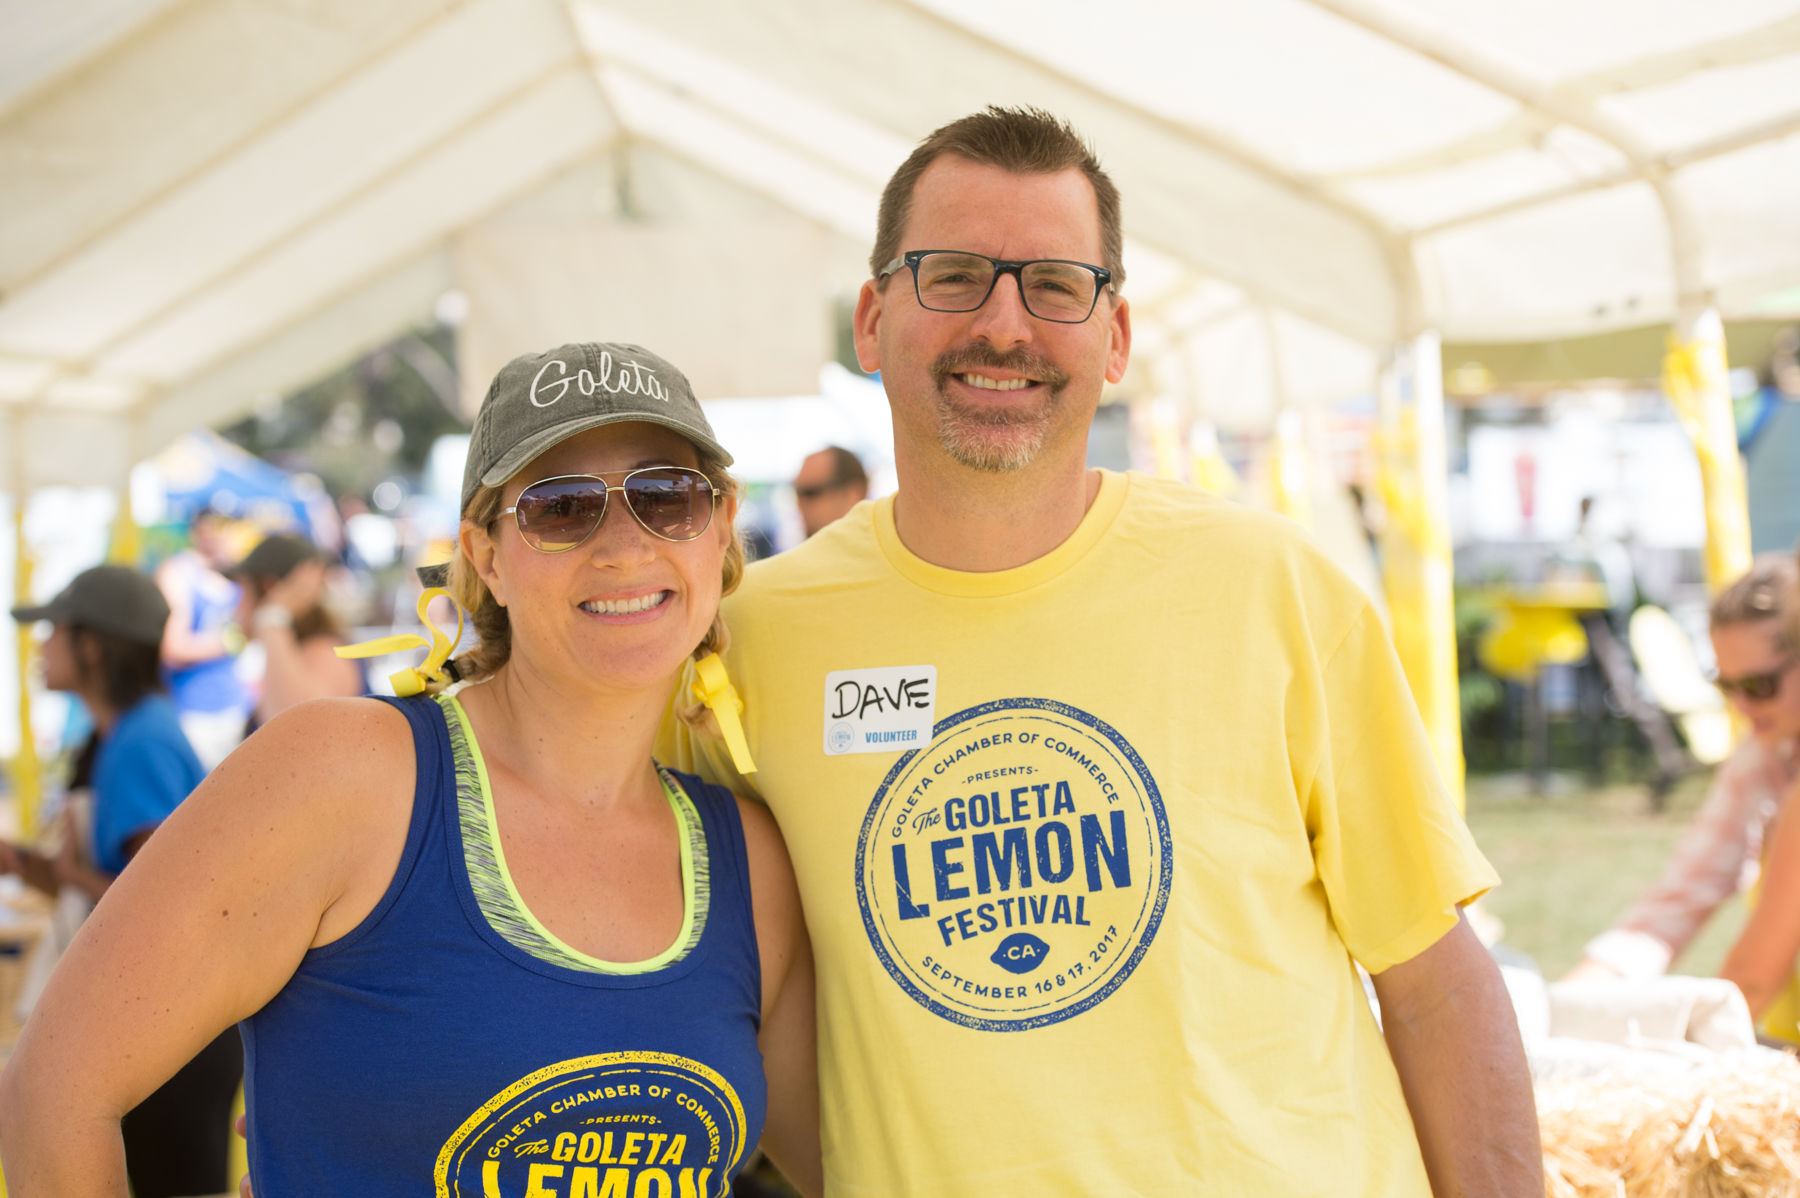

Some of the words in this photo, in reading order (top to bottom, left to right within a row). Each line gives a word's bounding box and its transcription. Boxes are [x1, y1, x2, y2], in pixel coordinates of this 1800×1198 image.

[530, 351, 669, 408] Goleta
[832, 678, 930, 720] DAVE
[865, 730, 918, 743] VOLUNTEER
[891, 777, 933, 838] GOLETA
[933, 733, 1014, 775] CHAMBER
[1018, 732, 1040, 744] OF
[1044, 736, 1119, 805] COMMERCE
[912, 806, 942, 835] The
[944, 780, 1076, 832] GOLETA
[891, 809, 1132, 921] LEMON
[937, 894, 1091, 947] FESTIVAL
[922, 956, 1028, 999] SEPTEMBER
[1035, 980, 1053, 994] 16
[1055, 974, 1067, 987] &
[1089, 924, 1119, 963] 2017
[488, 1112, 547, 1158] GOLETA
[550, 1084, 641, 1114] CHAMBER
[648, 1084, 672, 1099] OF
[676, 1094, 721, 1165] COMMERCE
[514, 1139, 549, 1158] The
[550, 1131, 687, 1165] GOLETA
